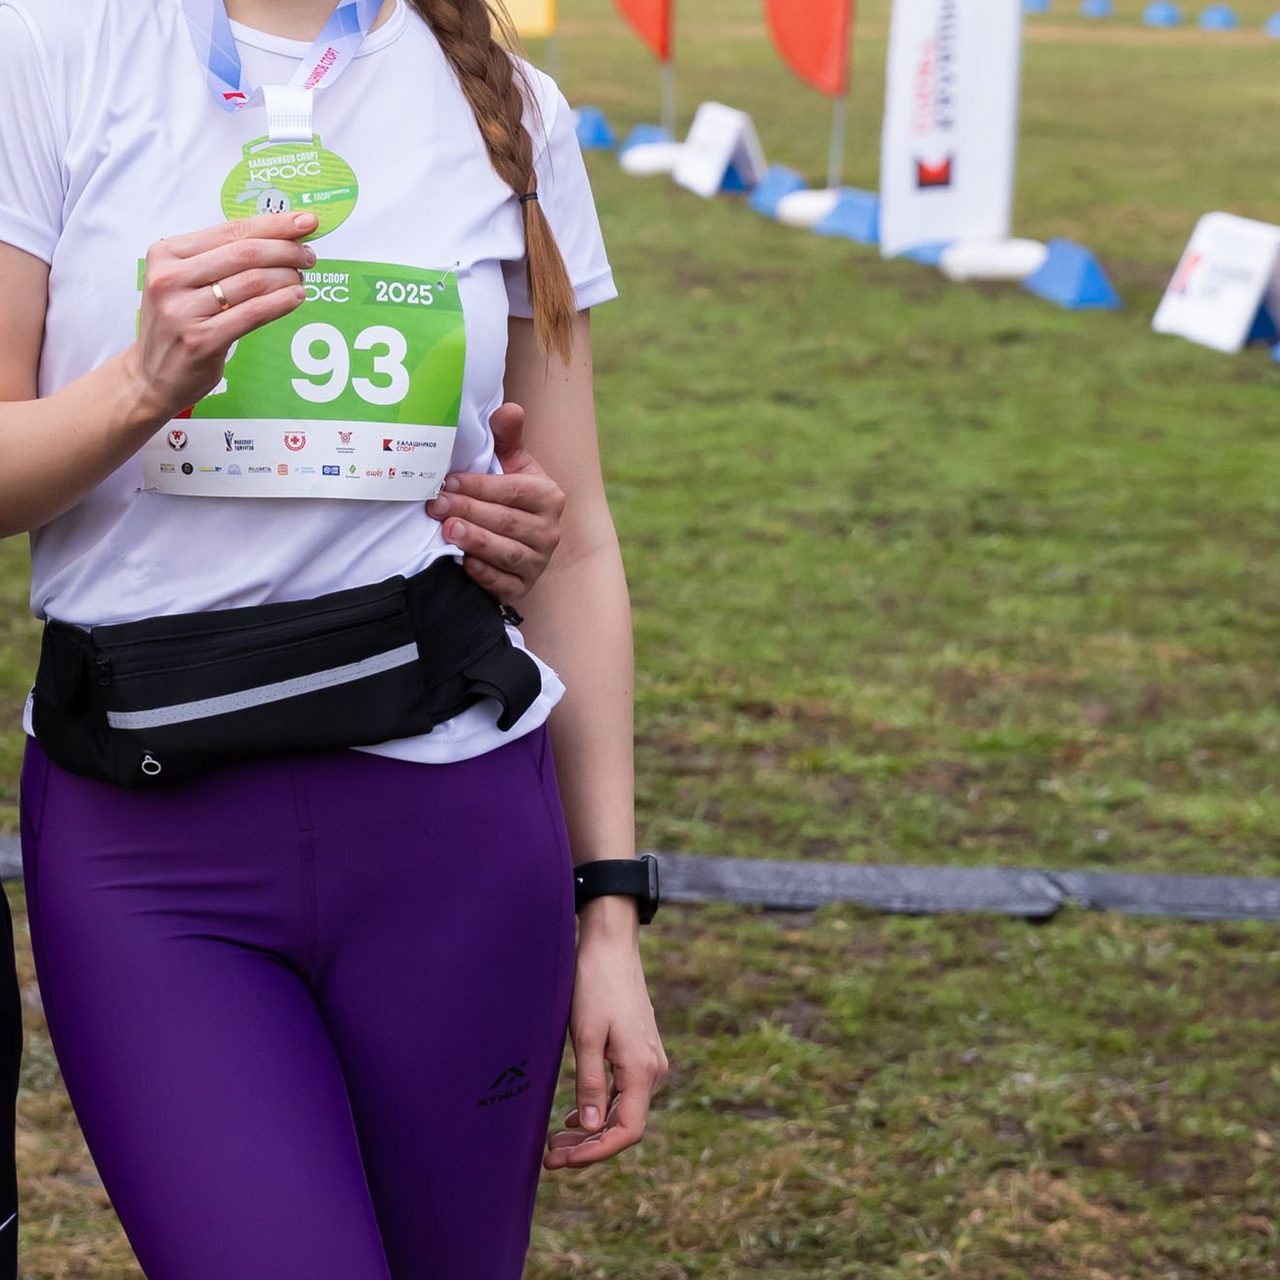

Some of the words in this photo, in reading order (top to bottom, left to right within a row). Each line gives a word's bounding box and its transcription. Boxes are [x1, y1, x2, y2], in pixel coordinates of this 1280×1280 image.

[248, 154, 296, 169] КАЛАШНИКОВ
[296, 151, 319, 163] СПОРТ
[250, 161, 322, 182] КРОСС
[323, 273, 350, 285] СПОРТ
[375, 280, 434, 305] 2025
[290, 322, 410, 406] 93
